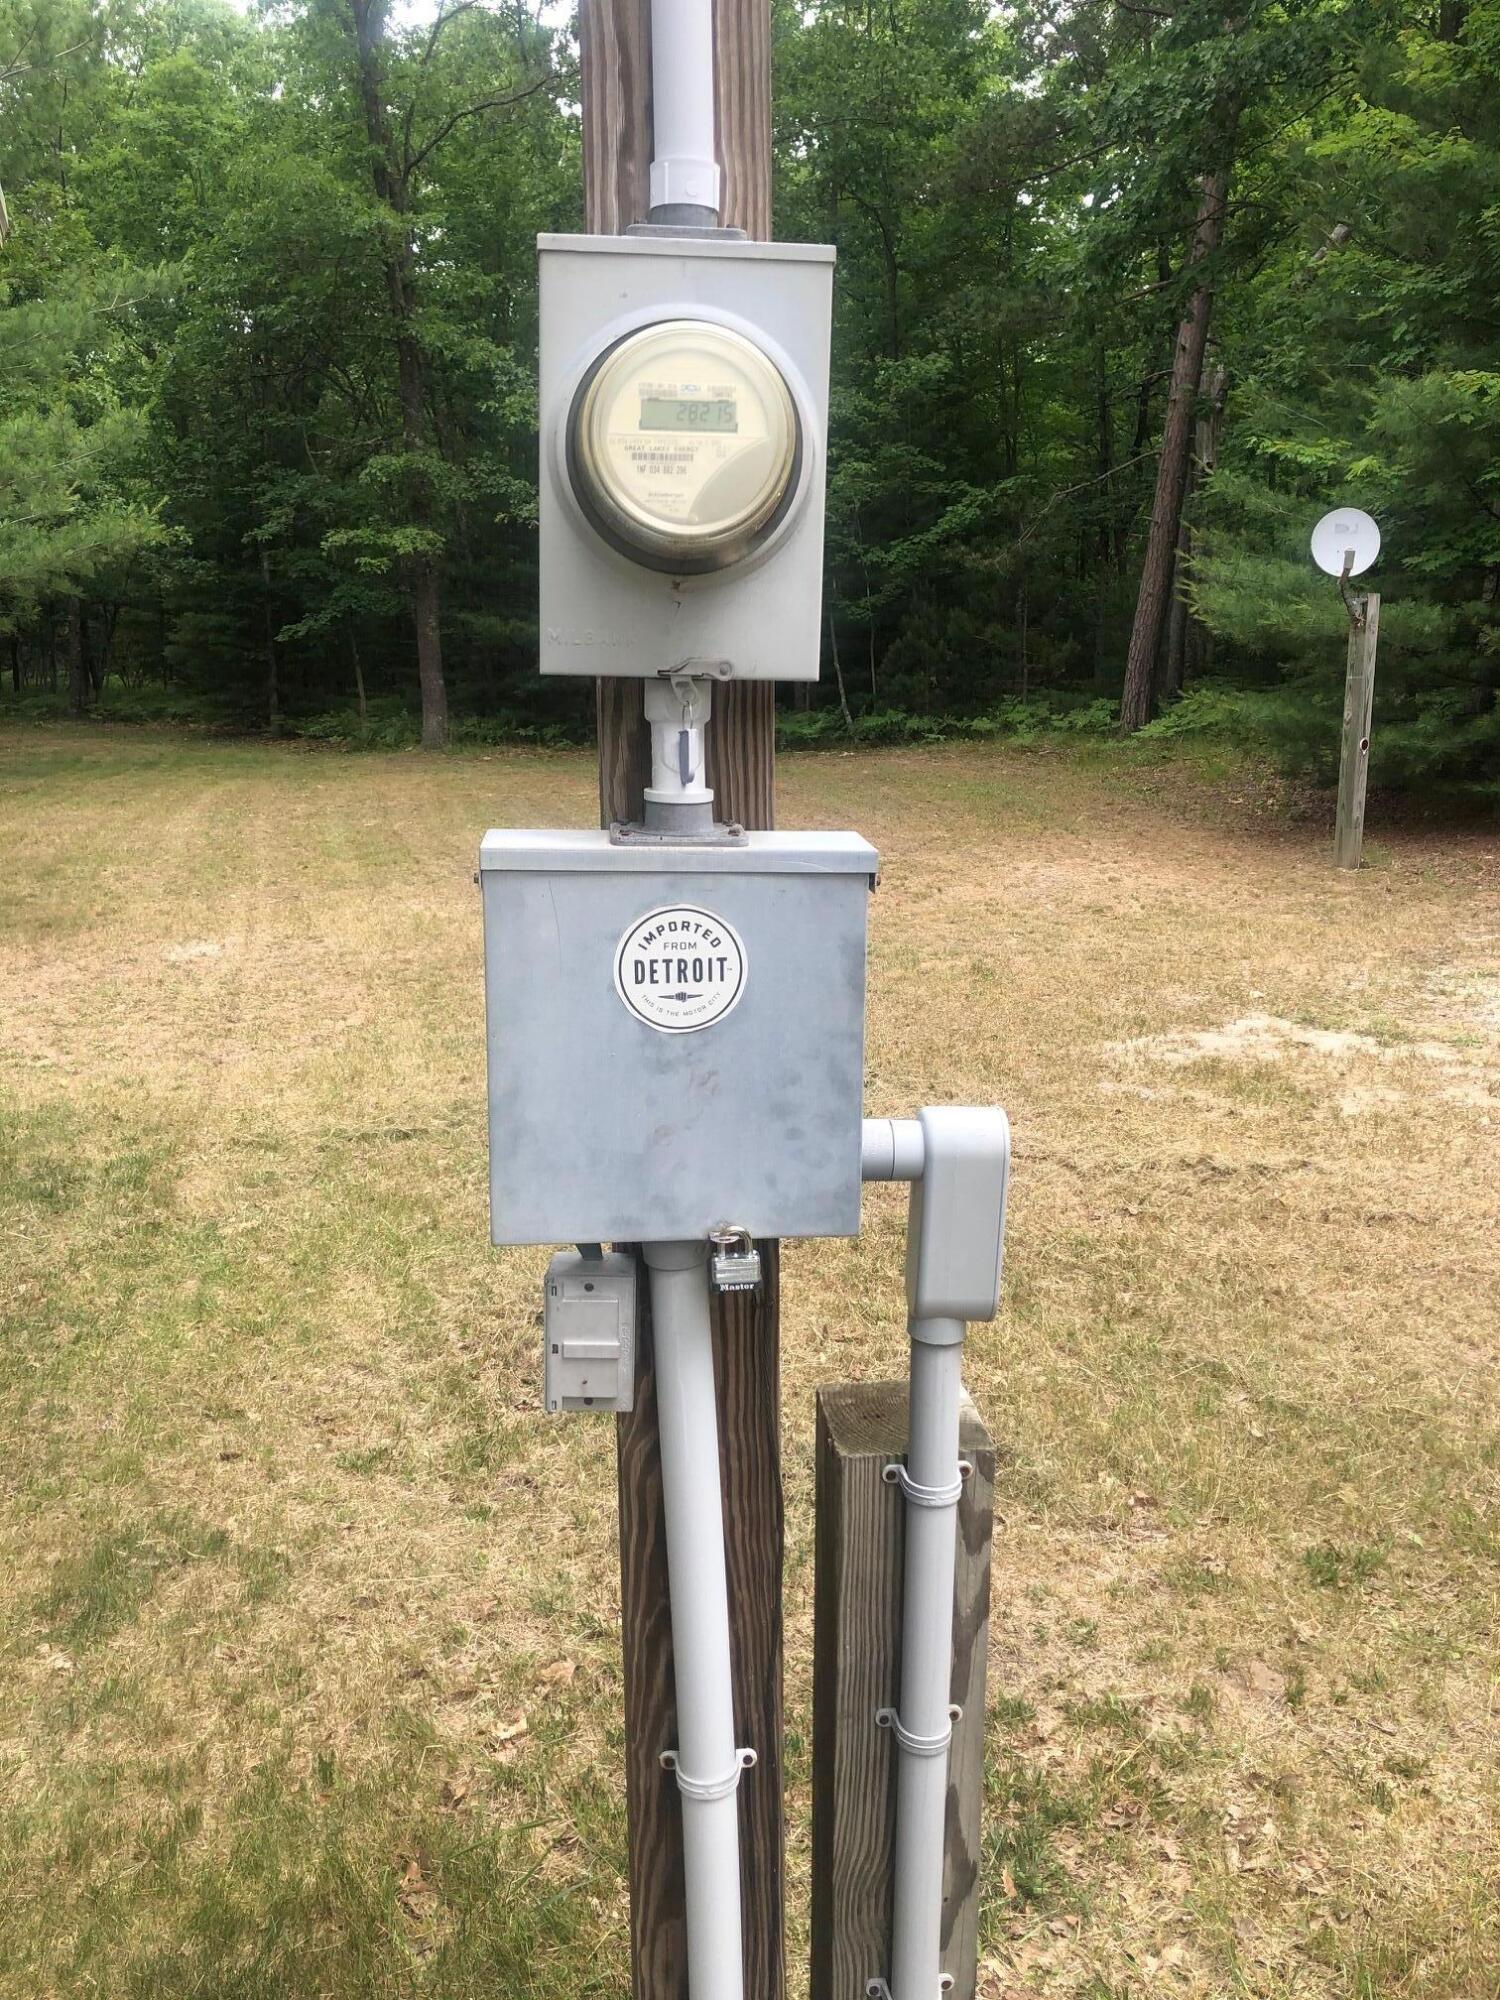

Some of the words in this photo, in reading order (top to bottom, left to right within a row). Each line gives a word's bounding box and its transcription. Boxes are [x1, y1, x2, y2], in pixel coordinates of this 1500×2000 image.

[676, 403, 733, 423] 28215
[638, 920, 722, 951] IMPORTED
[663, 941, 698, 951] FROM
[634, 956, 728, 985] DETROIT
[641, 994, 654, 1008] THIS
[656, 1006, 665, 1014] IS
[682, 1005, 707, 1016] MOTOR
[707, 991, 721, 1008] CITY
[720, 1284, 755, 1292] Master
